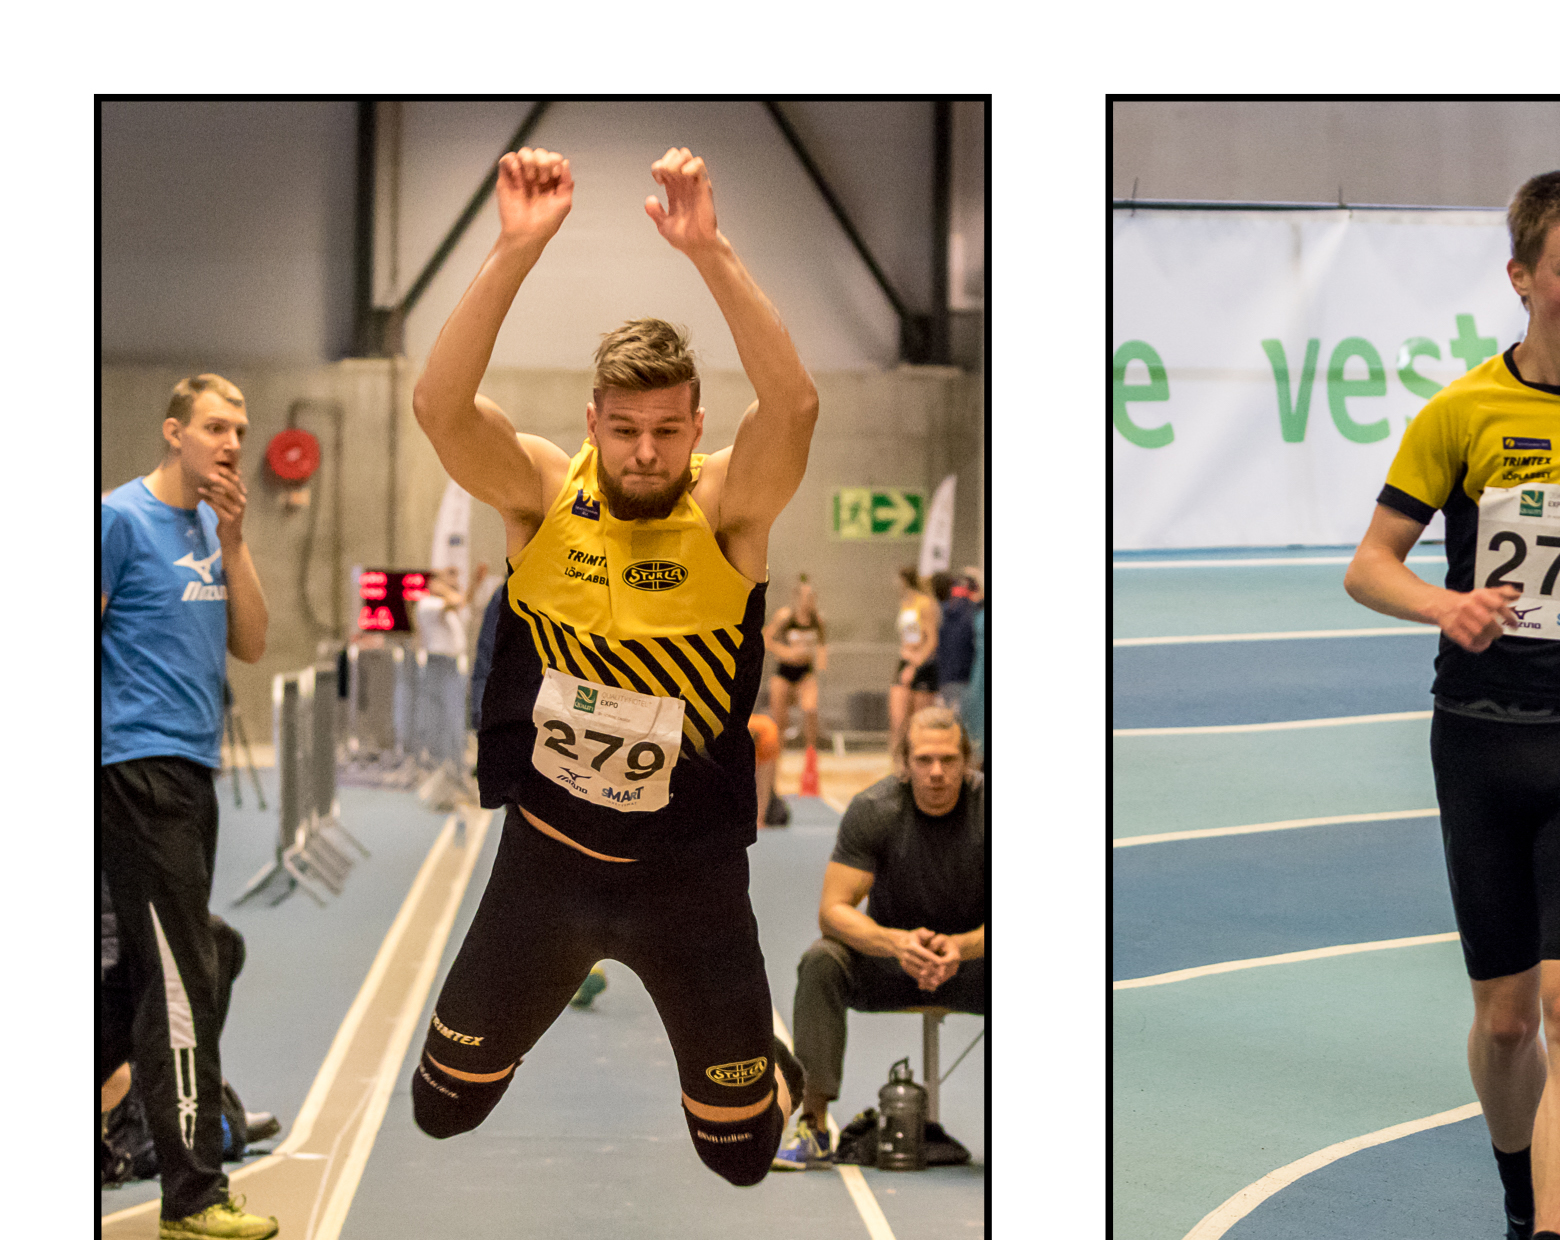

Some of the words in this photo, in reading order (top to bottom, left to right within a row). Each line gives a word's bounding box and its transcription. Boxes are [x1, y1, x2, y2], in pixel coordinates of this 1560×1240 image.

[1503, 456, 1552, 466] TRIMTEX
[600, 699, 619, 709] EXPO
[543, 719, 665, 781] 279
[601, 786, 644, 803] SMART
